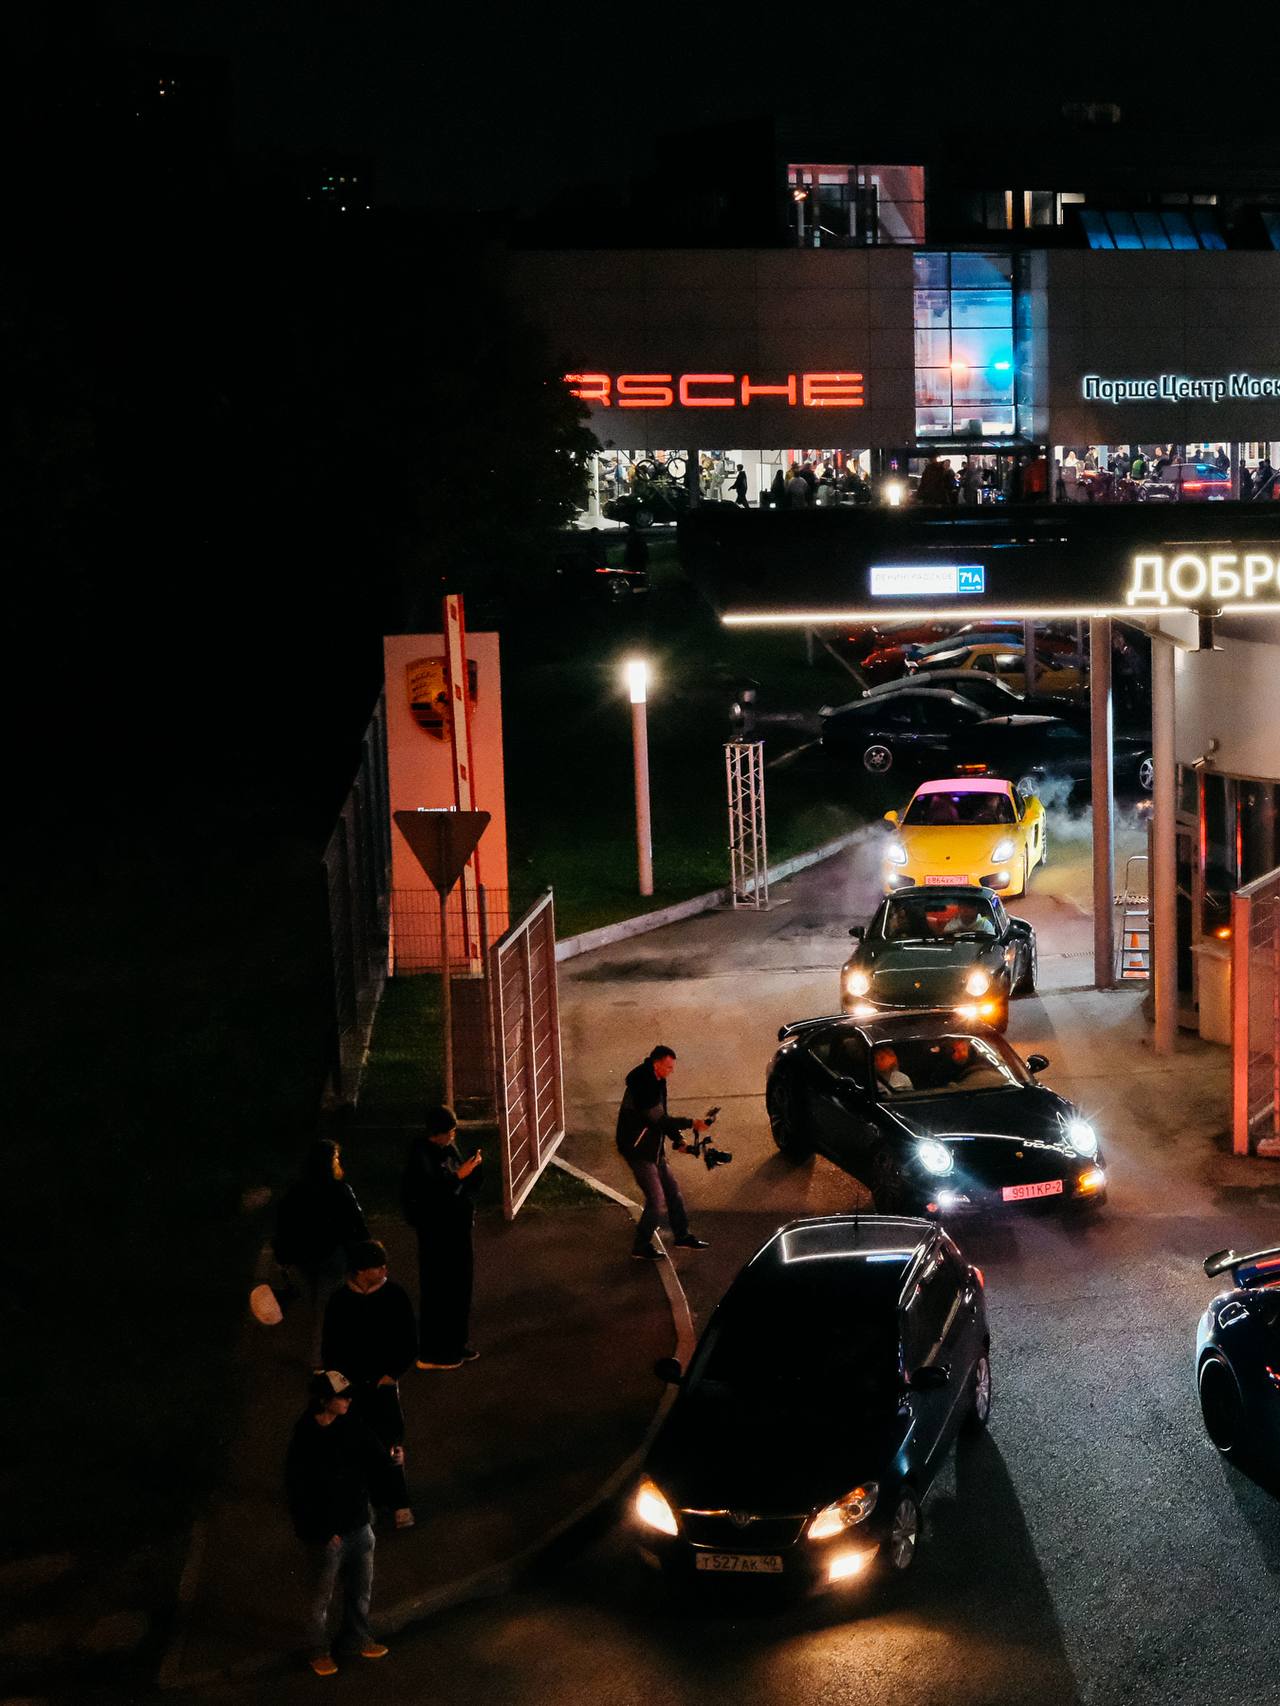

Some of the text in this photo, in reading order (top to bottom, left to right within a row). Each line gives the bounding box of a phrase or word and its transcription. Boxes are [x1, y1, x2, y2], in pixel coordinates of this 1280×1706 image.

[562, 373, 864, 407] RSCHE
[1083, 375, 1158, 404] Порше
[1161, 374, 1227, 403] Центр
